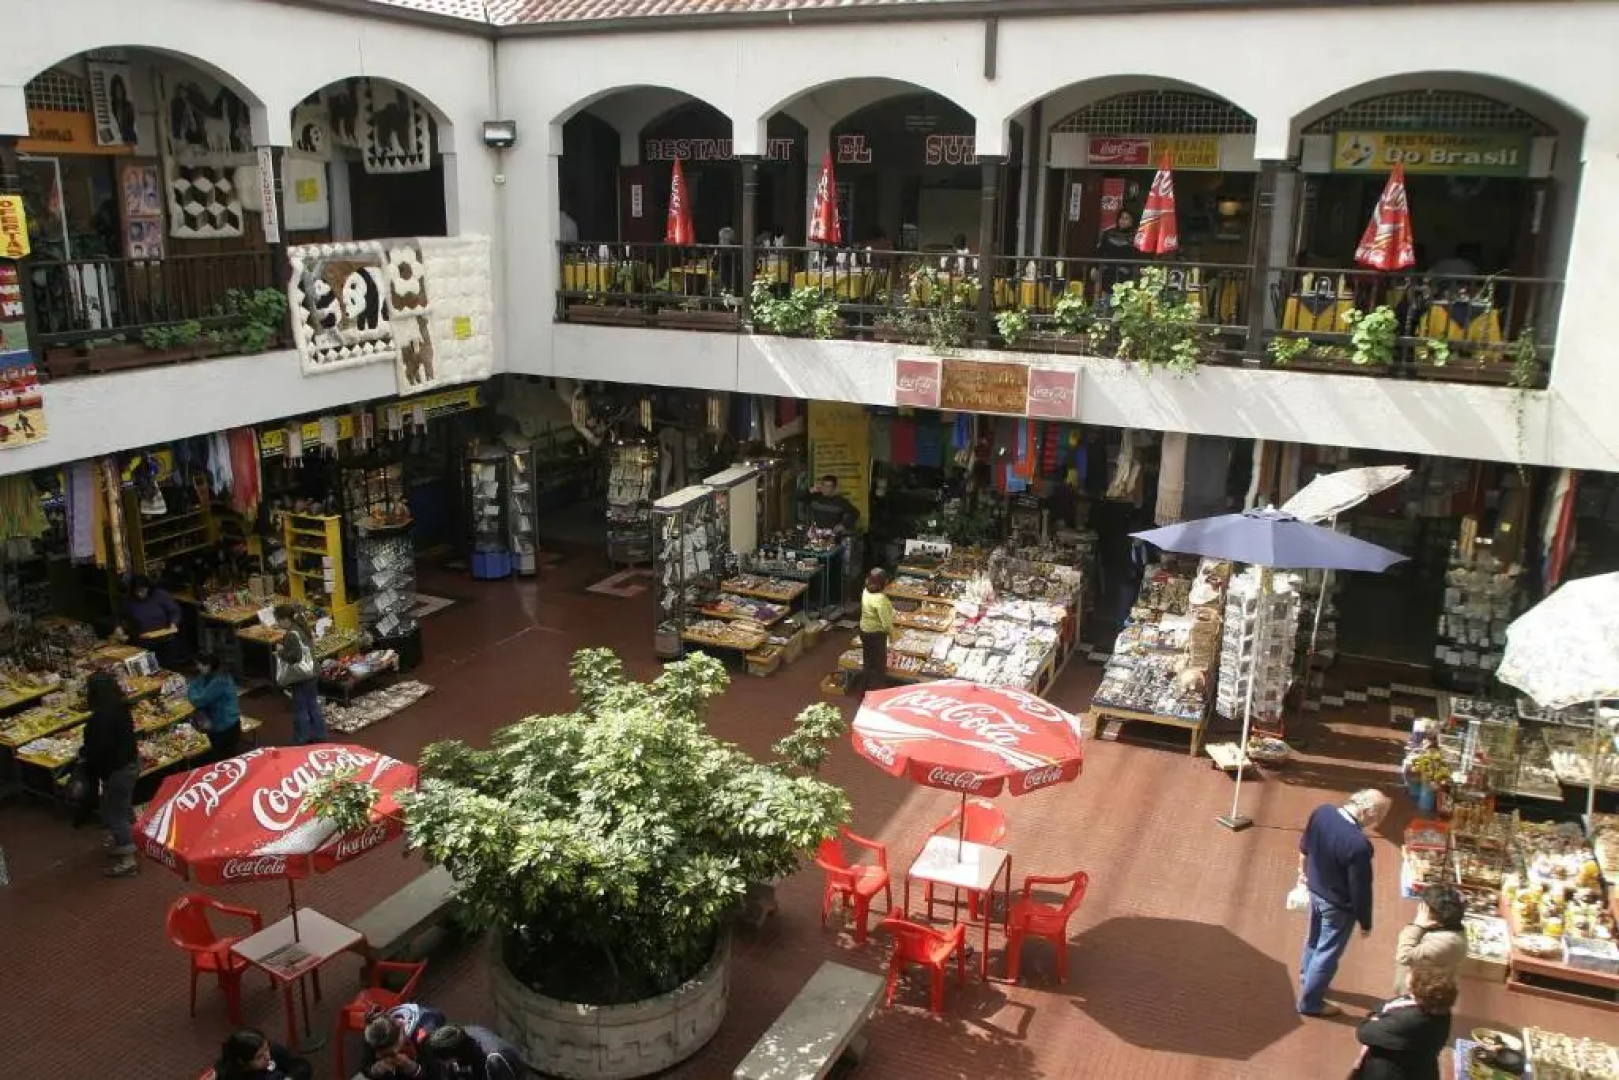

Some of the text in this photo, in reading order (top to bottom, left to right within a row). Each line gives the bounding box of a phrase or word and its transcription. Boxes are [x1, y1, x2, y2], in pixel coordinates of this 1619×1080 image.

[646, 138, 794, 161] RESTAUNT
[838, 135, 872, 164] EL
[1429, 146, 1519, 165] Brasil
